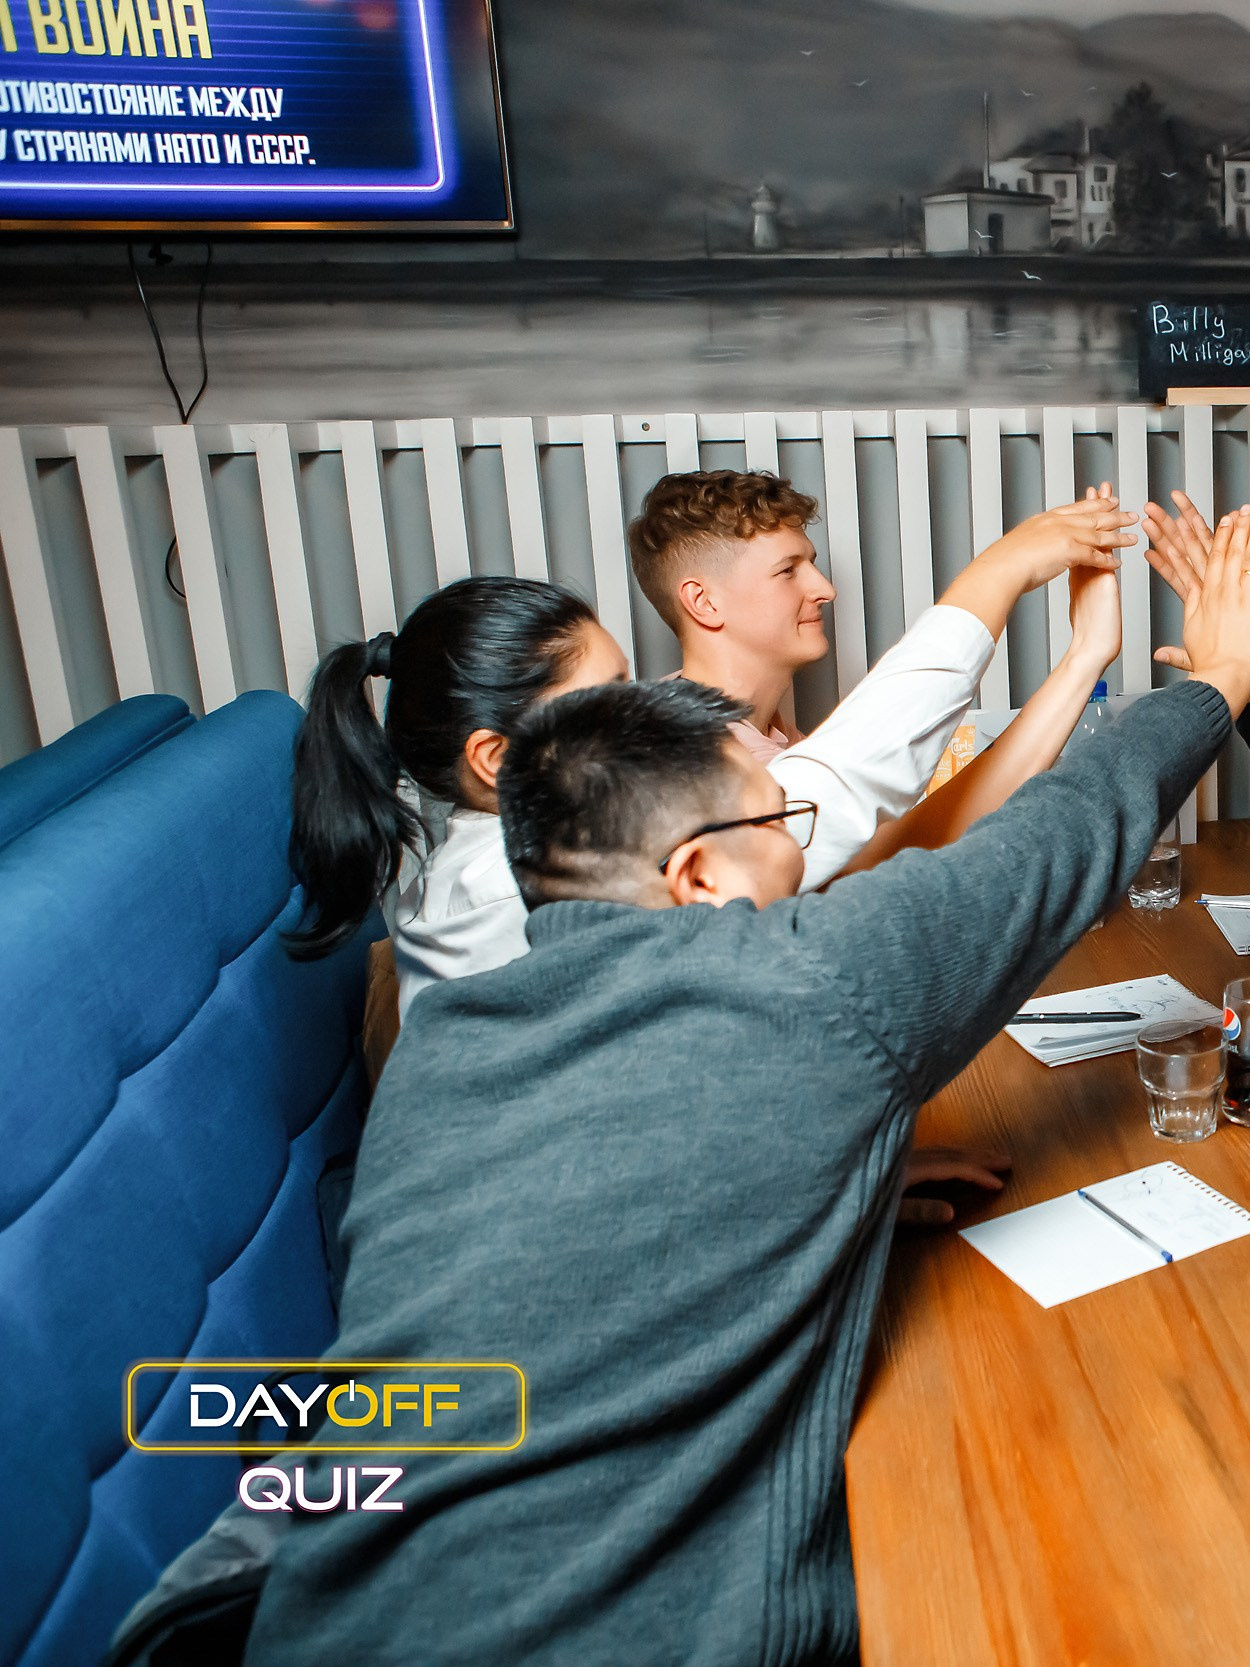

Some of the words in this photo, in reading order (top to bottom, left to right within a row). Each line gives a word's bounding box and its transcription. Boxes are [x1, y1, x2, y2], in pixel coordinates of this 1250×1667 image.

[187, 86, 283, 121] МЕЖДУ
[13, 129, 152, 163] СТРАНАМИ
[155, 132, 221, 164] НАТО
[223, 133, 244, 164] И
[246, 134, 316, 165] СССР.
[1152, 304, 1225, 339] Billy
